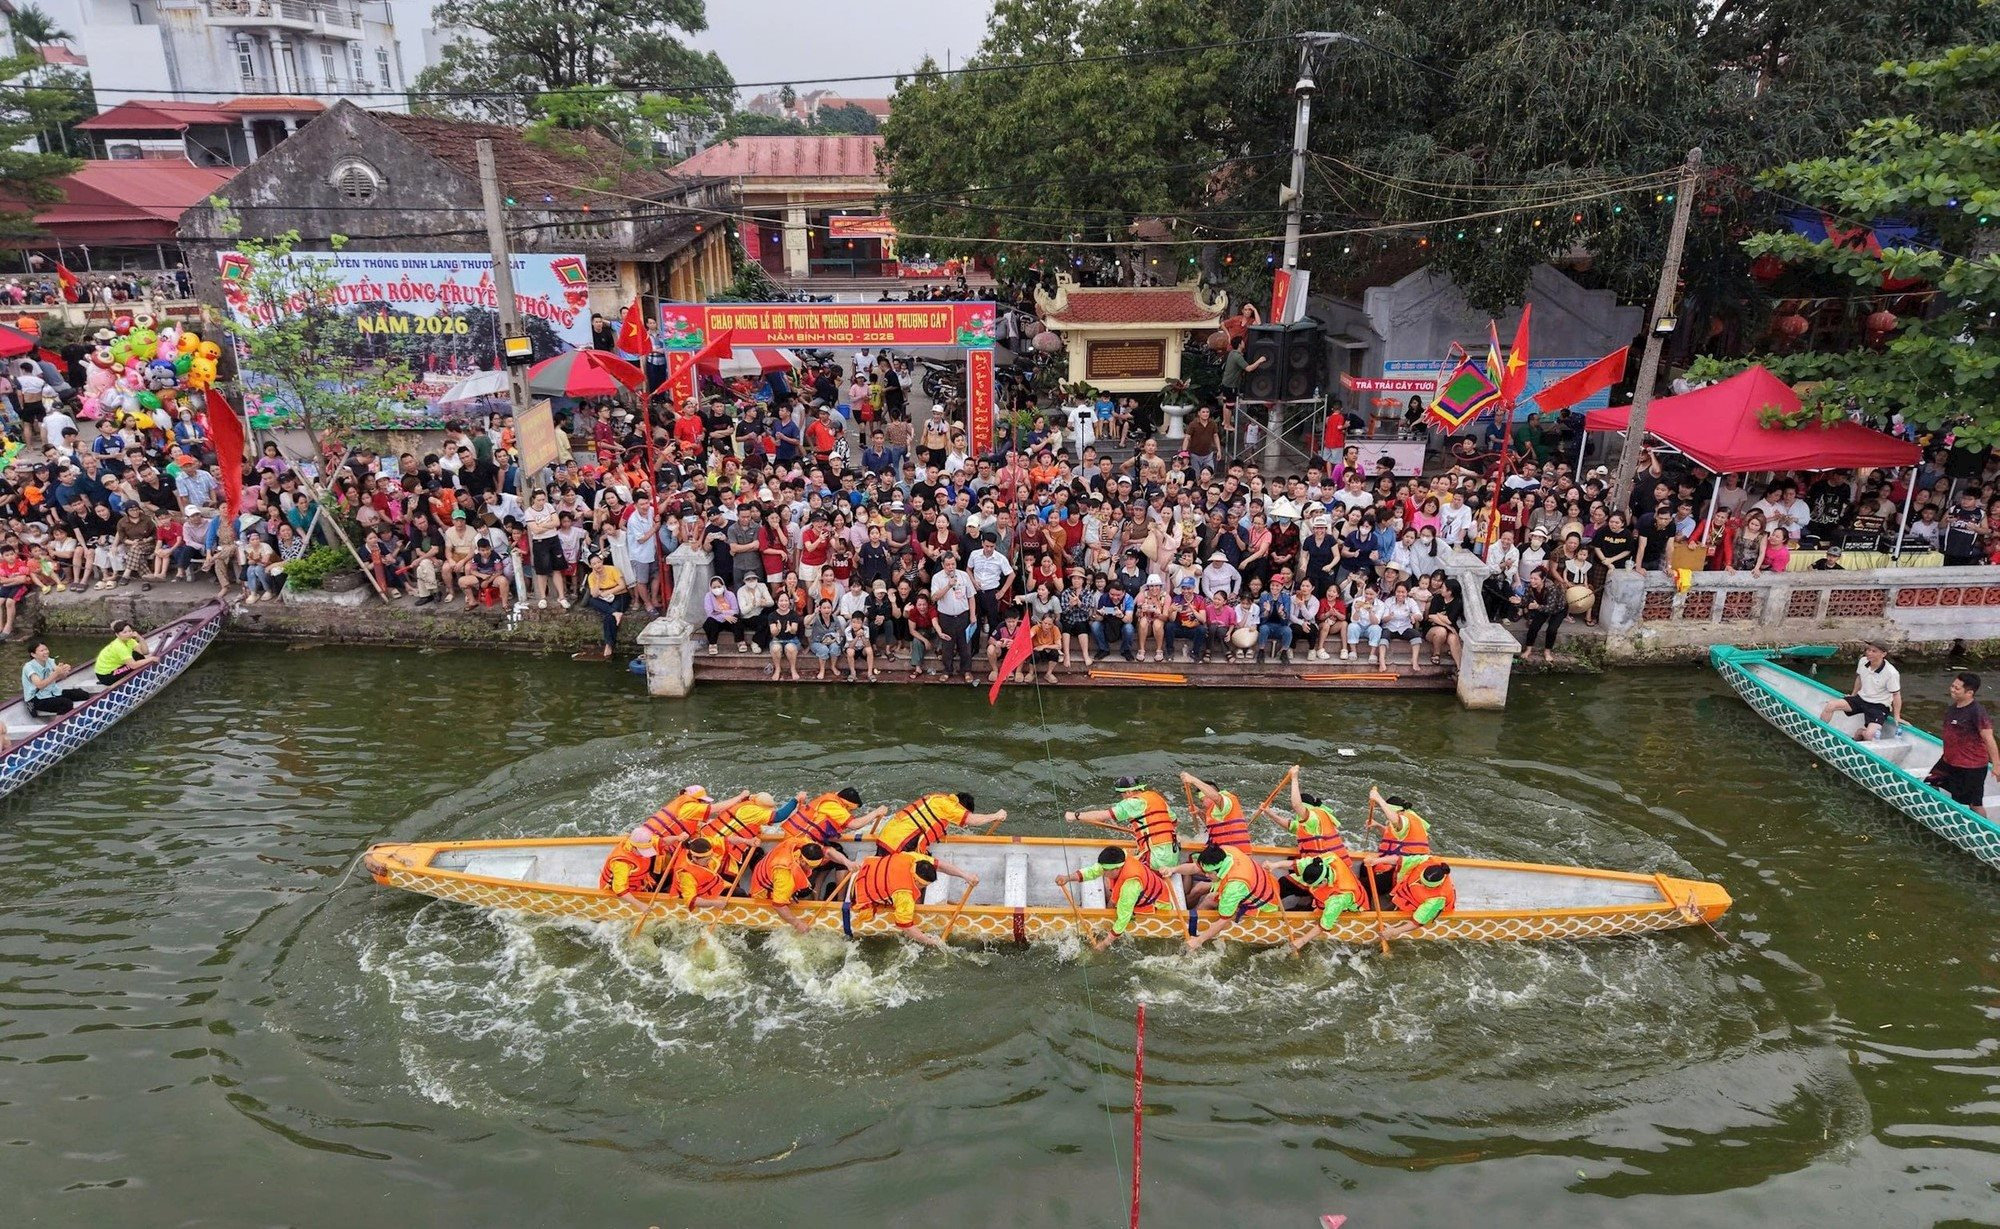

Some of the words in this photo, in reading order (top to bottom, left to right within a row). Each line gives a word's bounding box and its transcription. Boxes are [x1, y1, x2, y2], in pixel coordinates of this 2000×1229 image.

[387, 273, 436, 303] RỒNG
[440, 280, 496, 308] TRUYỀ
[515, 293, 574, 329] THỐNG
[357, 310, 409, 334] NĂM
[414, 315, 469, 335] 2026
[711, 312, 733, 330] CHÀO
[772, 312, 786, 330] HỘI
[788, 310, 820, 330] TRUYỀN
[822, 310, 849, 329] THỐNG
[873, 311, 893, 329] LÀNG
[930, 310, 948, 329] CÁT
[767, 330, 794, 341] NĂM
[828, 332, 853, 343] NGỌ
[863, 332, 895, 341] 2026
[1355, 380, 1372, 390] TRÀ
[1375, 380, 1393, 390] TRÁI
[1395, 380, 1414, 390] CÂY
[1415, 382, 1434, 391] TƯƠI
